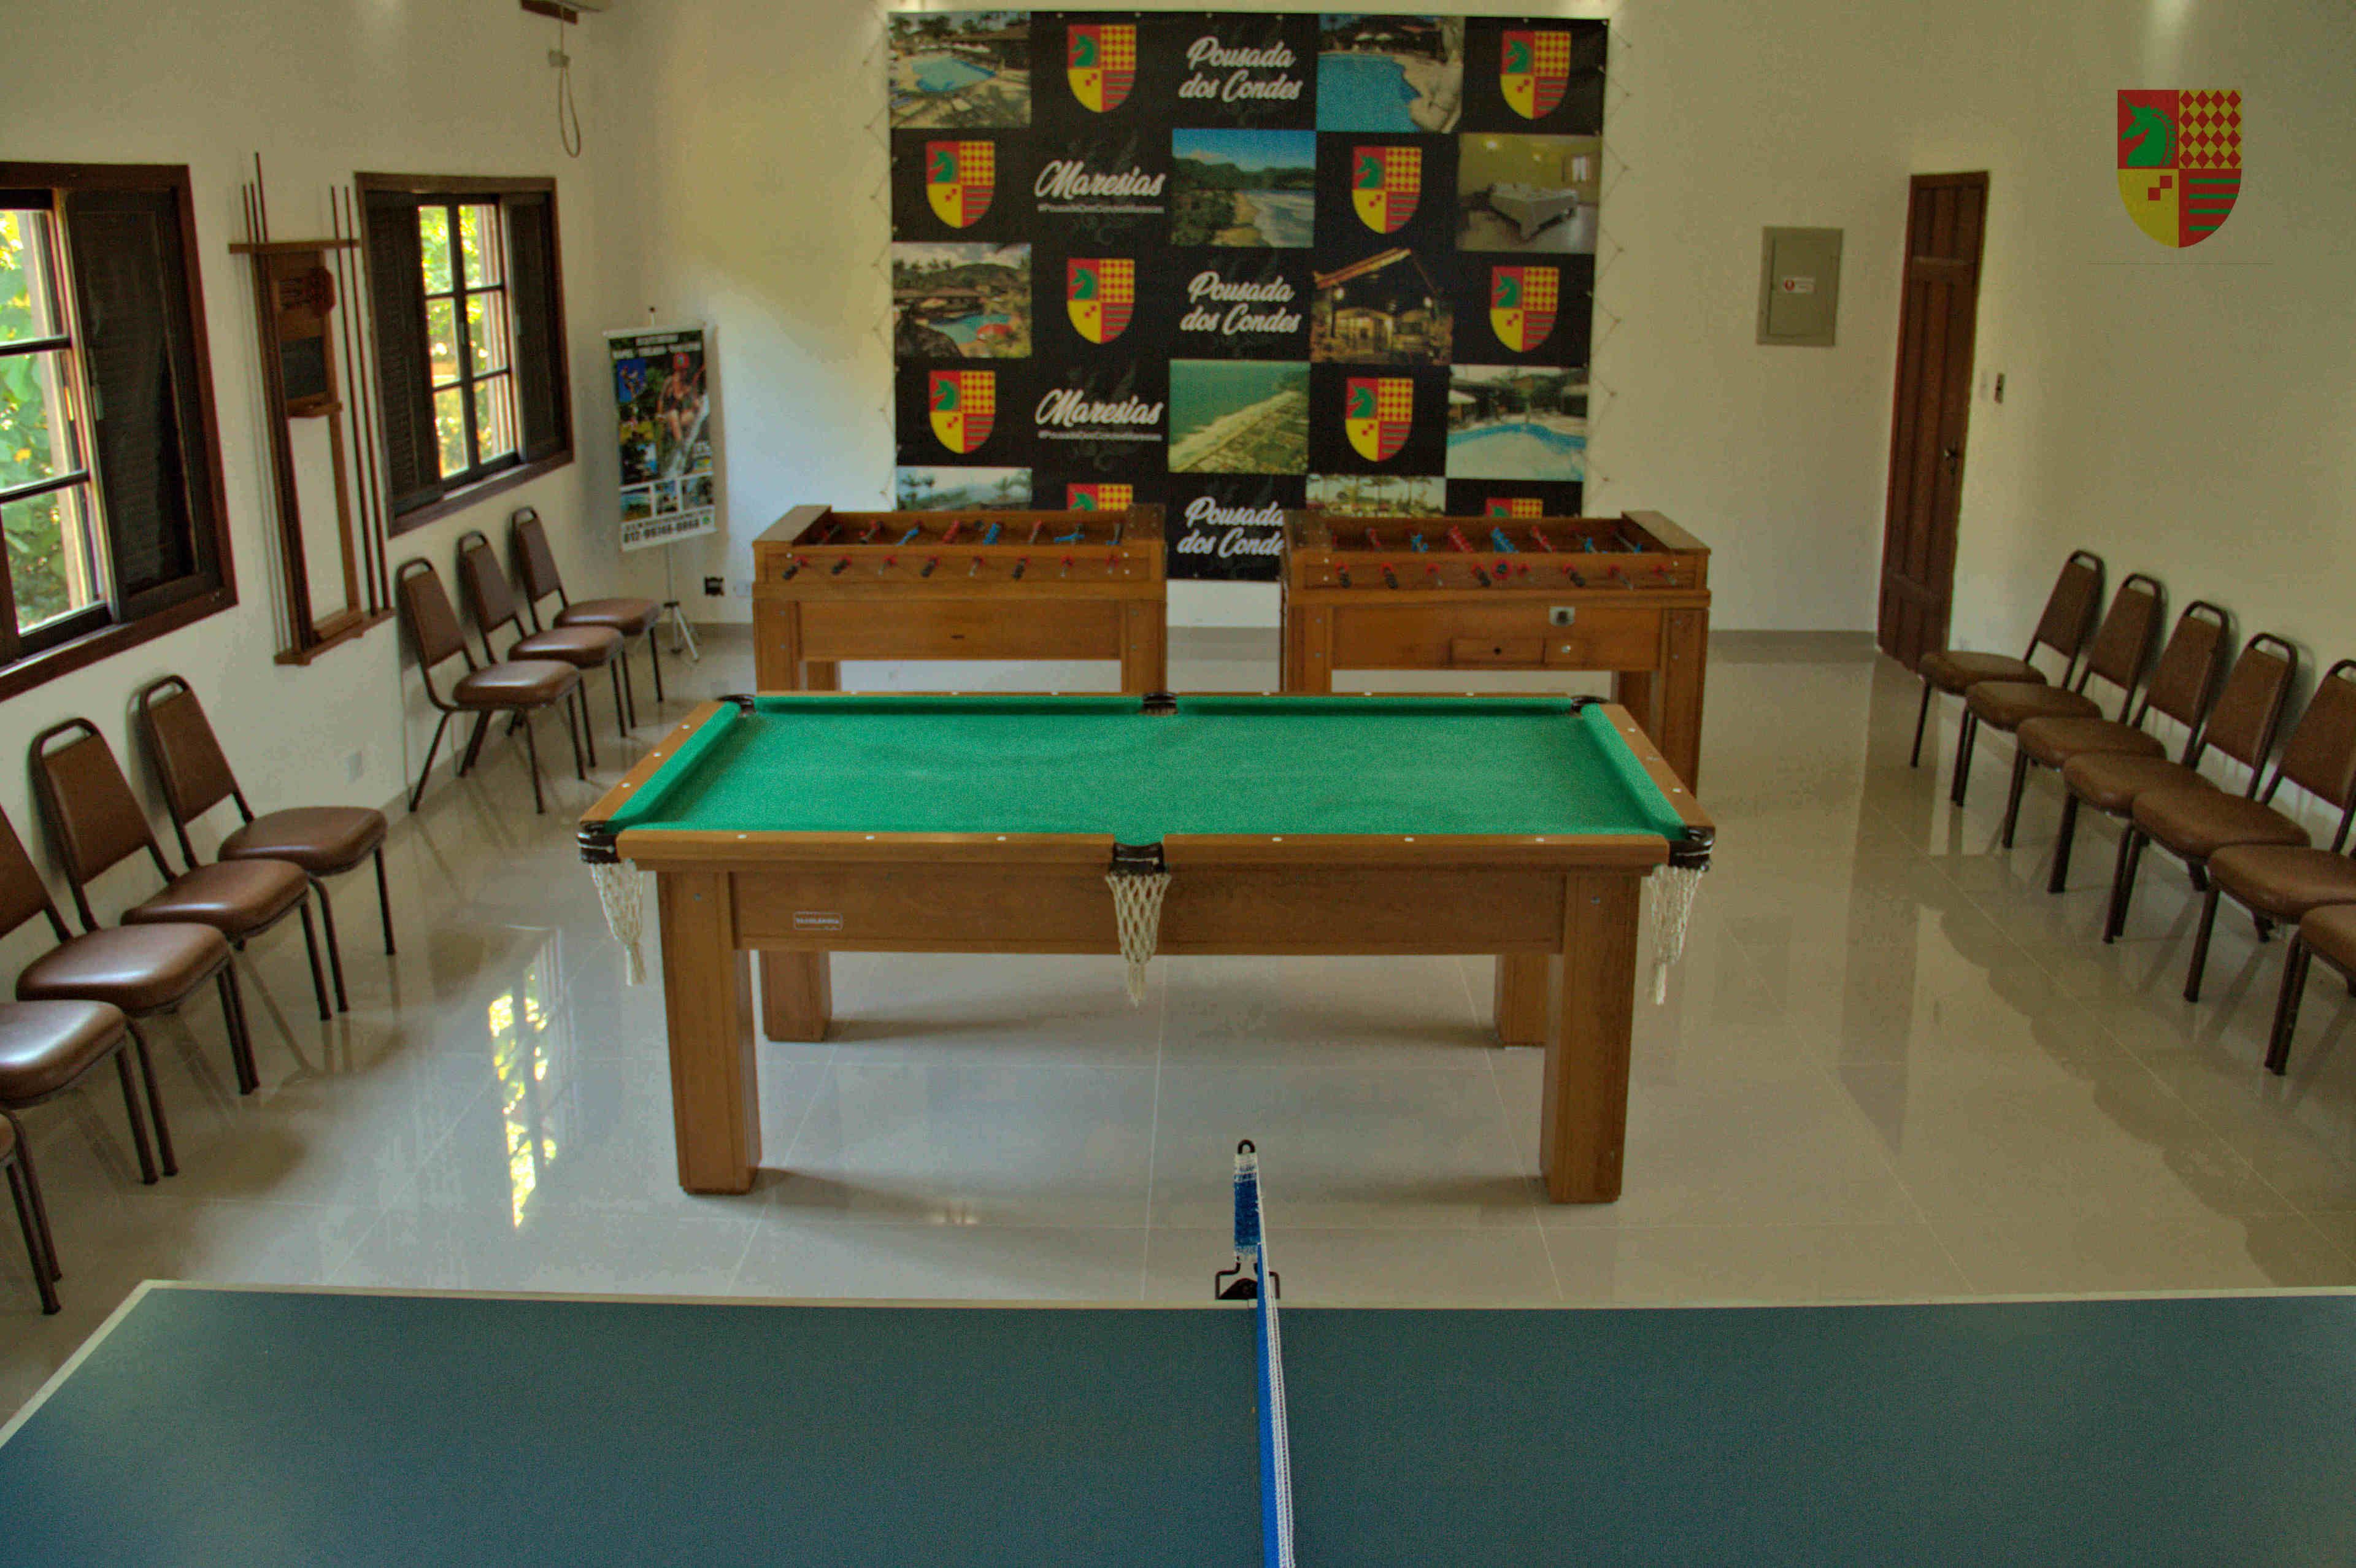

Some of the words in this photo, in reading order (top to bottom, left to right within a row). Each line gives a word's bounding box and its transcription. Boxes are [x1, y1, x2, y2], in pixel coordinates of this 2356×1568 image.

[1186, 36, 1296, 70] Pousada
[1178, 72, 1220, 98] dos
[1222, 69, 1303, 102] Condes
[1034, 159, 1165, 199] Maresias
[1187, 271, 1295, 304] Pousada
[1180, 306, 1220, 331] dos
[1222, 303, 1302, 336] Condes
[1035, 388, 1164, 427] Maresias
[1185, 496, 1285, 528] Pousada
[1177, 529, 1217, 554] dos
[1218, 527, 1285, 558] Conde
